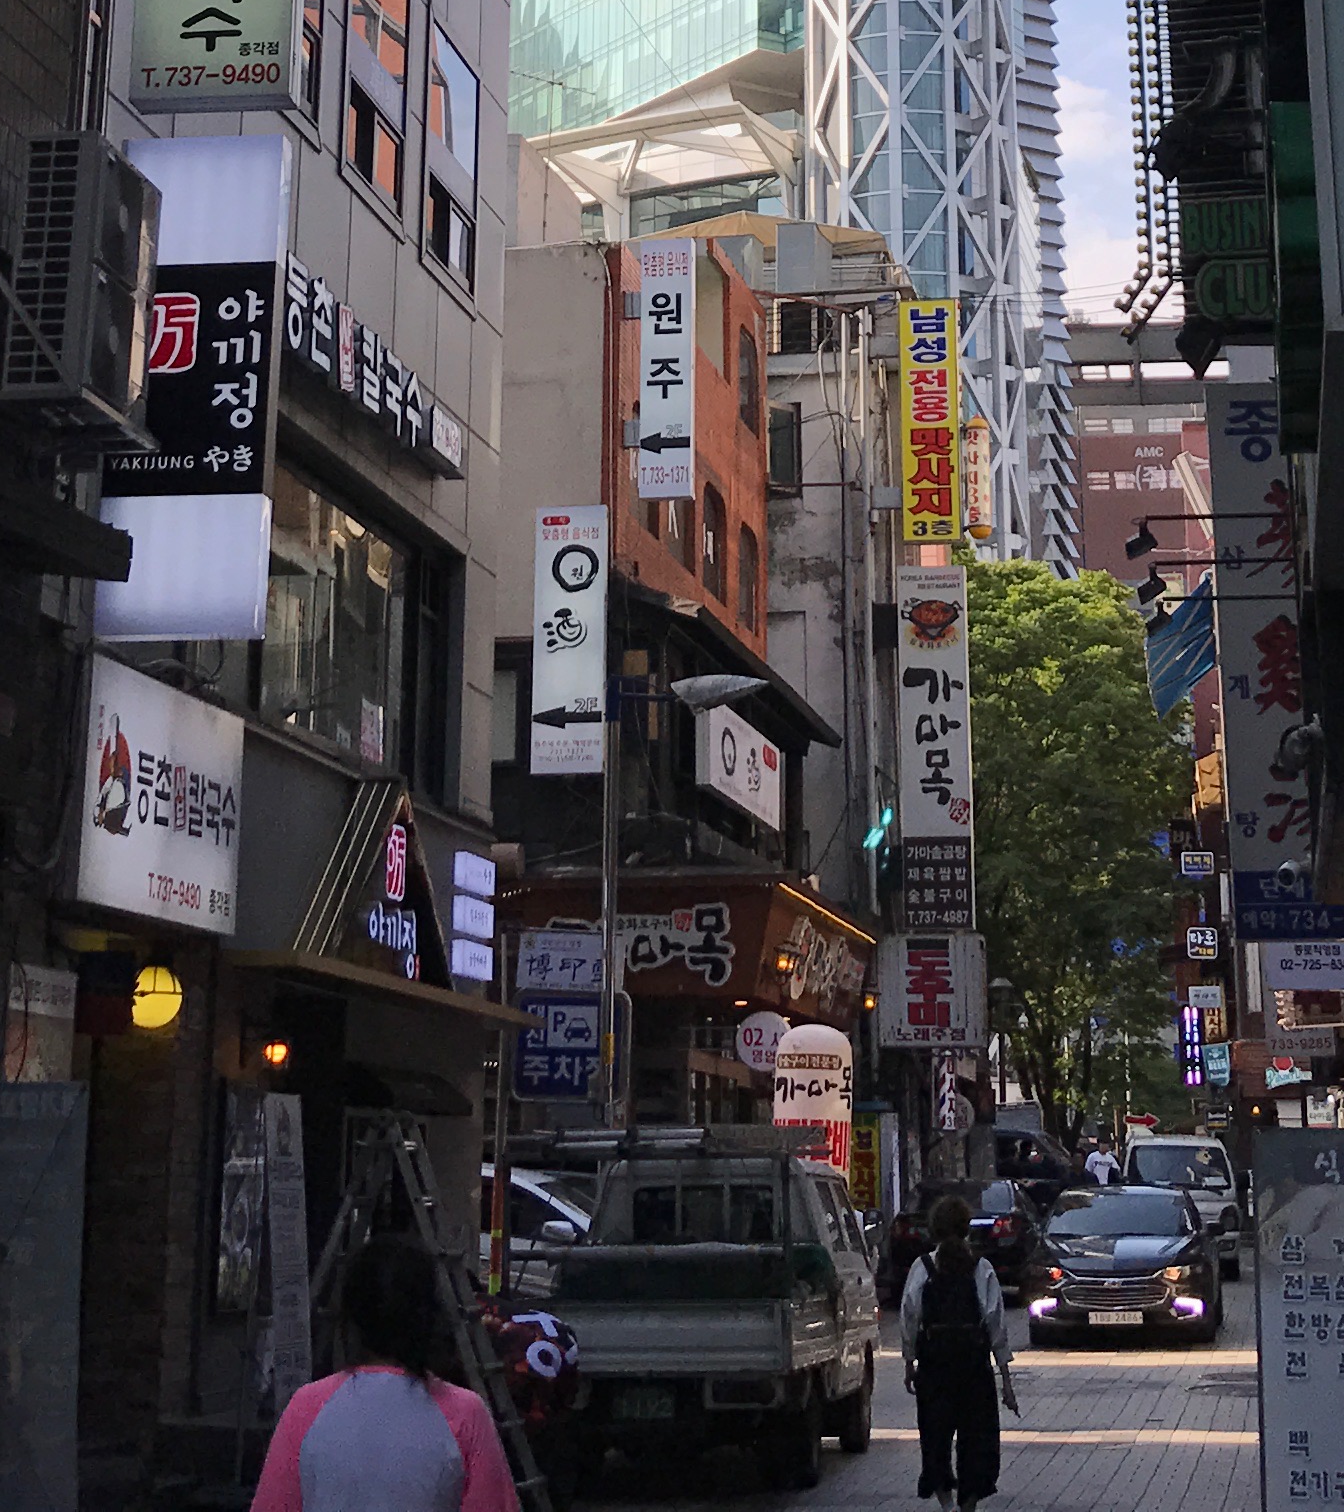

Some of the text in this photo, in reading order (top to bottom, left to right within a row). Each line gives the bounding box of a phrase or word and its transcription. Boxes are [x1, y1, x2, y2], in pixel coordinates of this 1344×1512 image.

[238, 41, 280, 57] 종각점
[1183, 201, 1270, 255] BUSIN
[667, 251, 689, 276] 음식점
[1203, 262, 1269, 316] CLU
[211, 289, 265, 429] 야끼정
[646, 293, 684, 400] 원주
[908, 307, 954, 517] 남성 전용 맛사지
[666, 424, 683, 439] 2F
[109, 455, 195, 471] YAKIJUNG
[203, 444, 254, 473] やき
[1134, 446, 1164, 458] AMC
[912, 520, 954, 537] 3층
[574, 696, 598, 714] 2F
[902, 666, 964, 806] 가마목
[369, 901, 417, 979] 야끼정
[553, 1011, 566, 1033] P
[895, 1027, 966, 1042] 노래주점
[1270, 1037, 1332, 1050] 733-9285
[775, 1066, 852, 1110] 가마목
